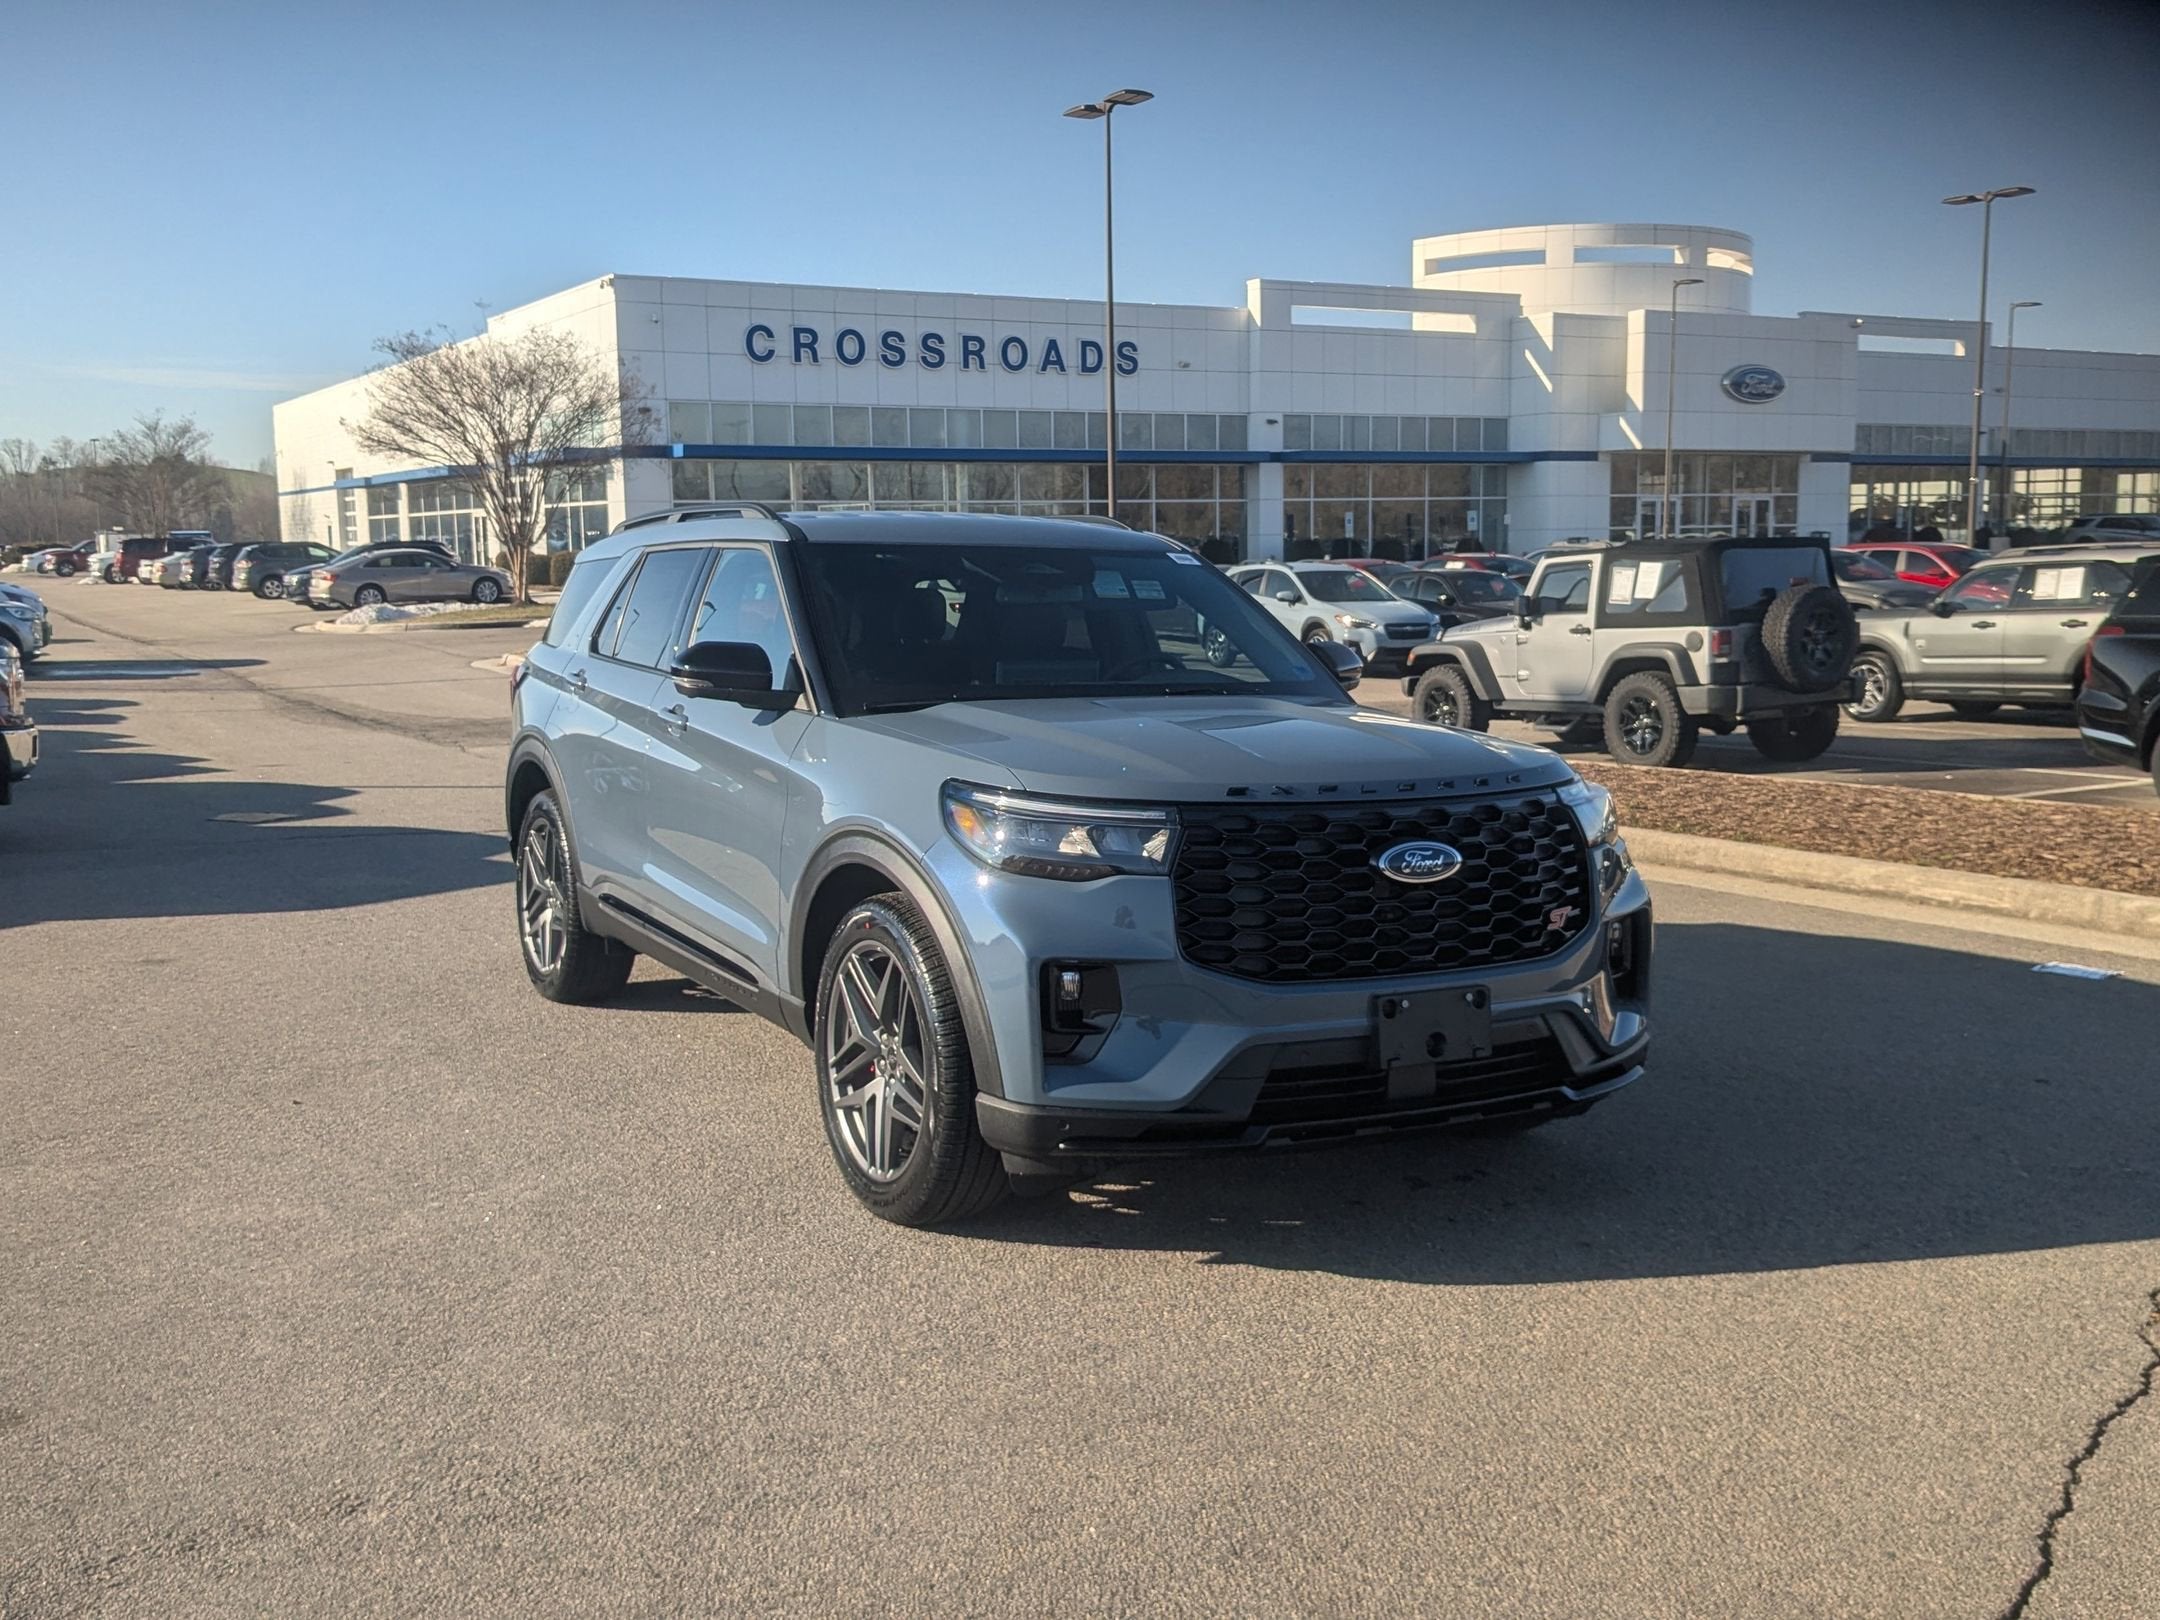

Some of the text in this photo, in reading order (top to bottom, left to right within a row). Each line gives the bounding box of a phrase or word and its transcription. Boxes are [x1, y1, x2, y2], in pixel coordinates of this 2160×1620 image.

[745, 323, 1140, 376] CROSSROADS
[1401, 850, 1445, 873] Ford
[1547, 905, 1572, 930] ST
